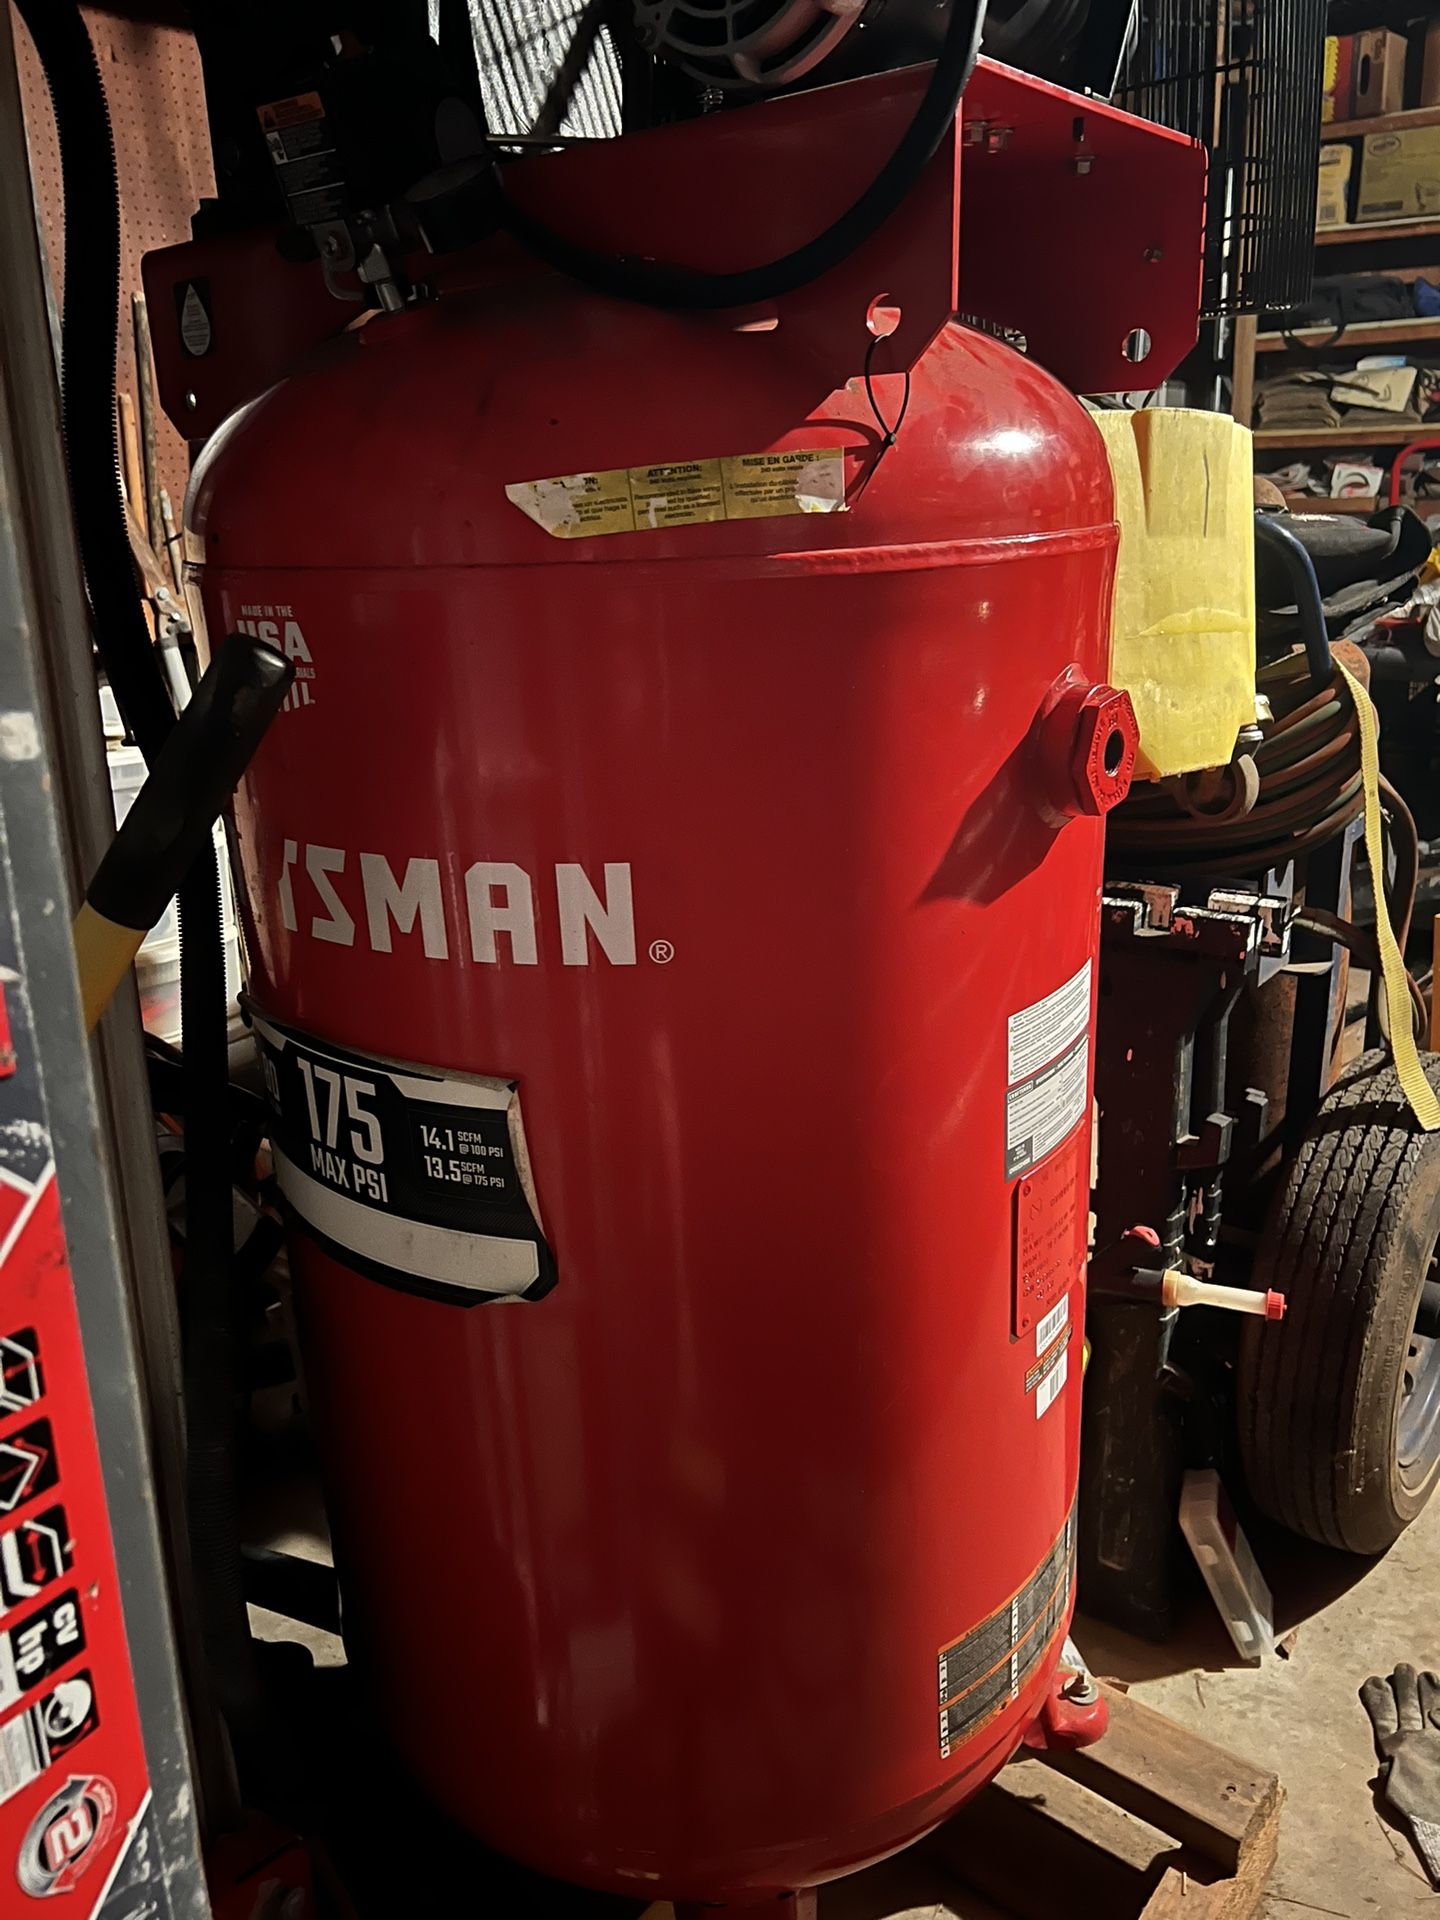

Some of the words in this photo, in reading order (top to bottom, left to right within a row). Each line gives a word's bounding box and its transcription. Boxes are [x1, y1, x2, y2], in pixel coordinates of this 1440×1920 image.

[767, 456, 780, 465] EN
[782, 453, 814, 464] GARDE
[264, 605, 274, 617] IN
[275, 605, 294, 618] THE
[297, 1056, 385, 1165] 175
[420, 1124, 454, 1152] 14.1
[457, 1130, 482, 1144] SCFM
[458, 1143, 470, 1155] @
[470, 1144, 487, 1156] 100
[488, 1146, 504, 1158] PSI
[310, 1143, 350, 1190] MAX
[352, 1163, 389, 1204] PSI
[423, 1155, 462, 1182] 13.5
[460, 1161, 485, 1175] SCFM
[462, 1173, 473, 1185] @
[473, 1174, 489, 1187] 175
[489, 1177, 505, 1188] PSI
[53, 1602, 79, 1646] cv
[15, 1619, 48, 1675] hp
